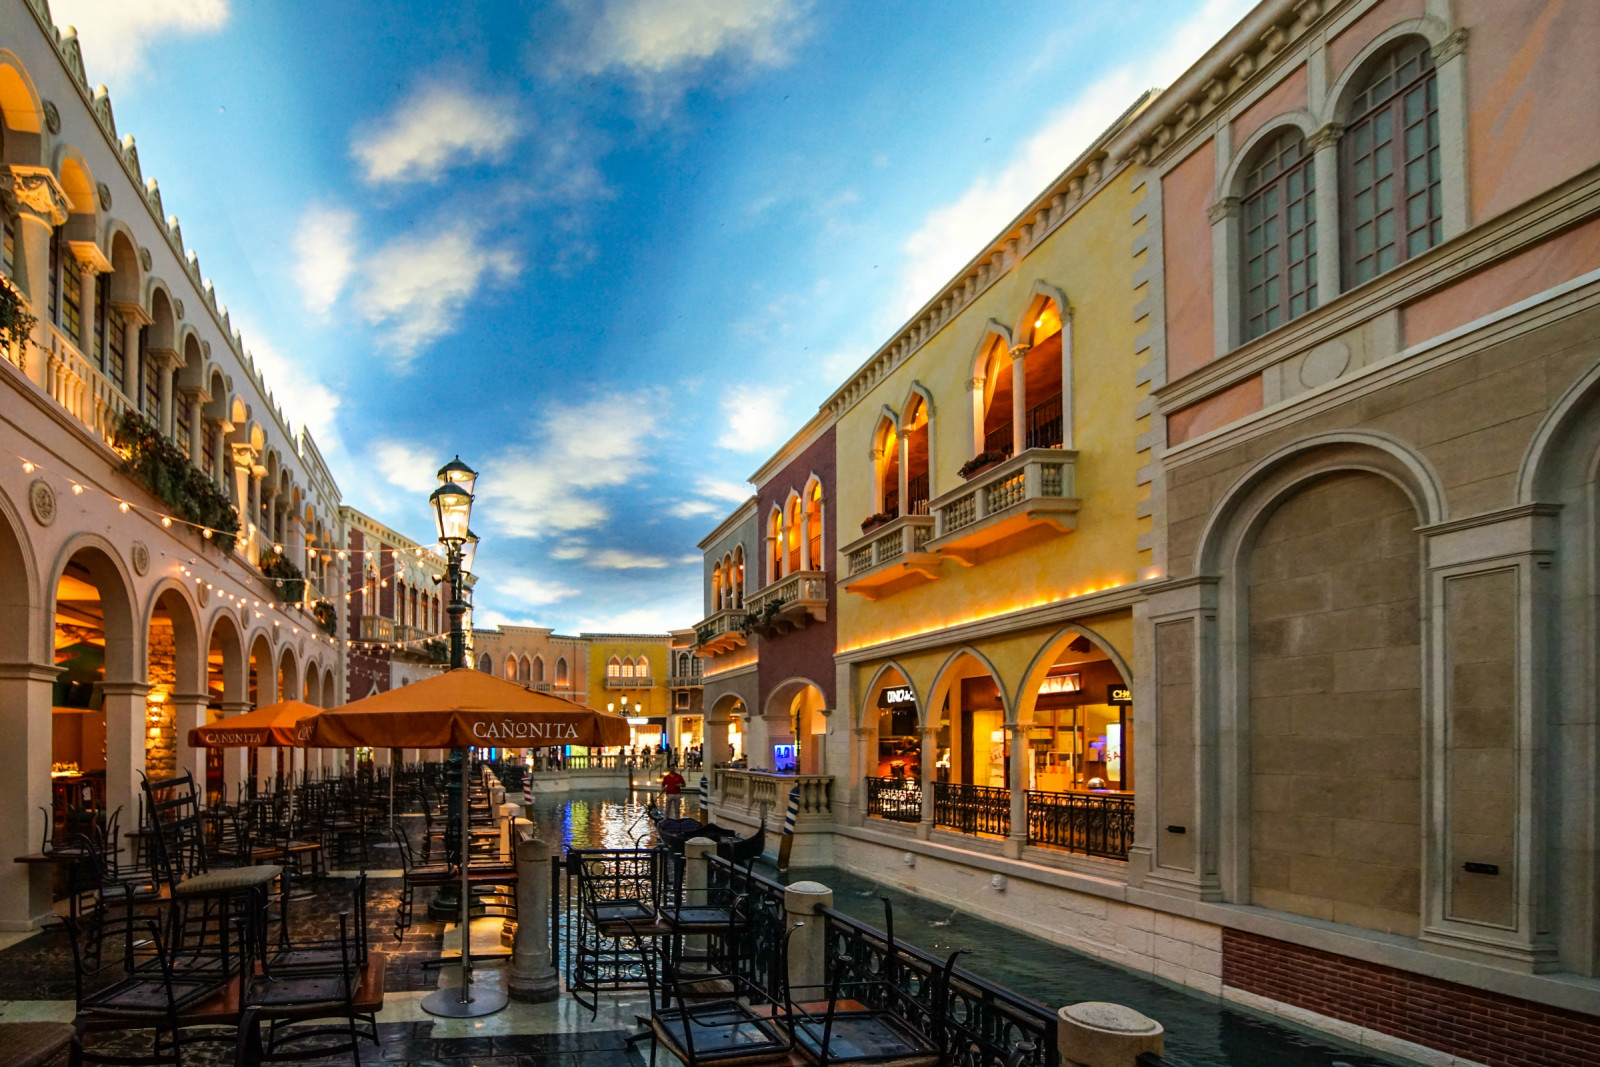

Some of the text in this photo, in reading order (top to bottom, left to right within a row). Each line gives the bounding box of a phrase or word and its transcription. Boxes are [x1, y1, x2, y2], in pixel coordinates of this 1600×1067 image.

[1038, 676, 1074, 694] ANA
[473, 719, 578, 738] CAÑONITA
[1106, 751, 1121, 762] SA
